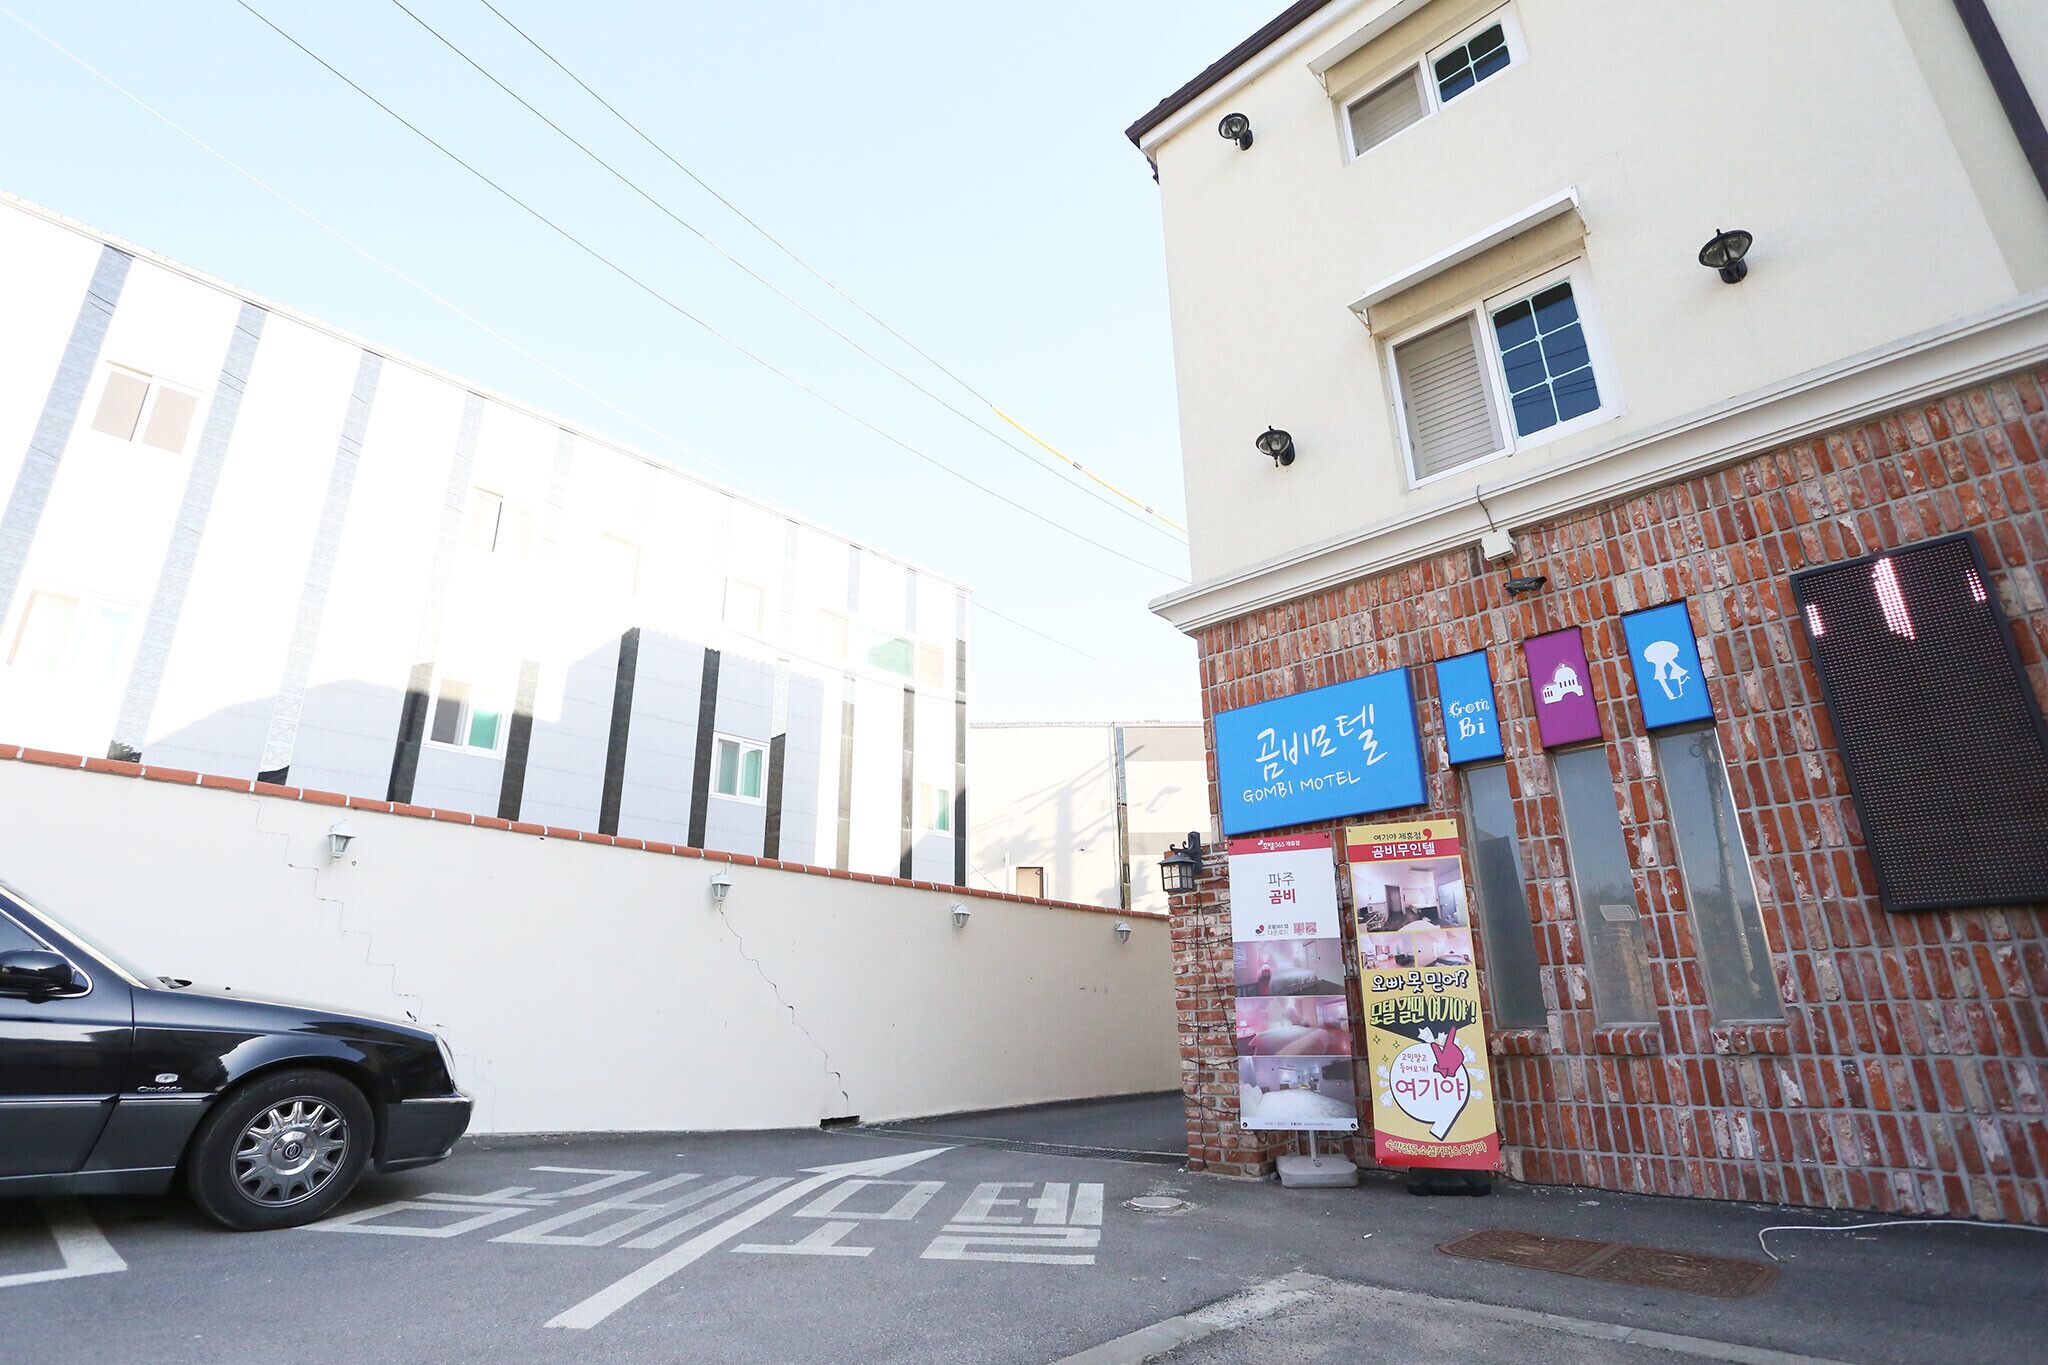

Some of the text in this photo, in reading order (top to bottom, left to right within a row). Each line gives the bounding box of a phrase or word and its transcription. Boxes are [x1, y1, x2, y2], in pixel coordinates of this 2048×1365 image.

[1448, 699, 1490, 717] Gom
[1458, 717, 1486, 740] Bi
[1255, 703, 1389, 782] 곰비모텔
[1243, 771, 1361, 803] GOMBI MOTEL
[1398, 831, 1422, 840] 제휴점
[1371, 841, 1436, 859] 곰비무인텔
[1268, 872, 1296, 888] 파주
[1268, 888, 1297, 905] 곰비
[1372, 969, 1469, 993] 오빠 못 믿어?
[1370, 998, 1396, 1025] 모텔
[1396, 1078, 1464, 1101] 여기야
[298, 1165, 1105, 1265] 곰비모텔
